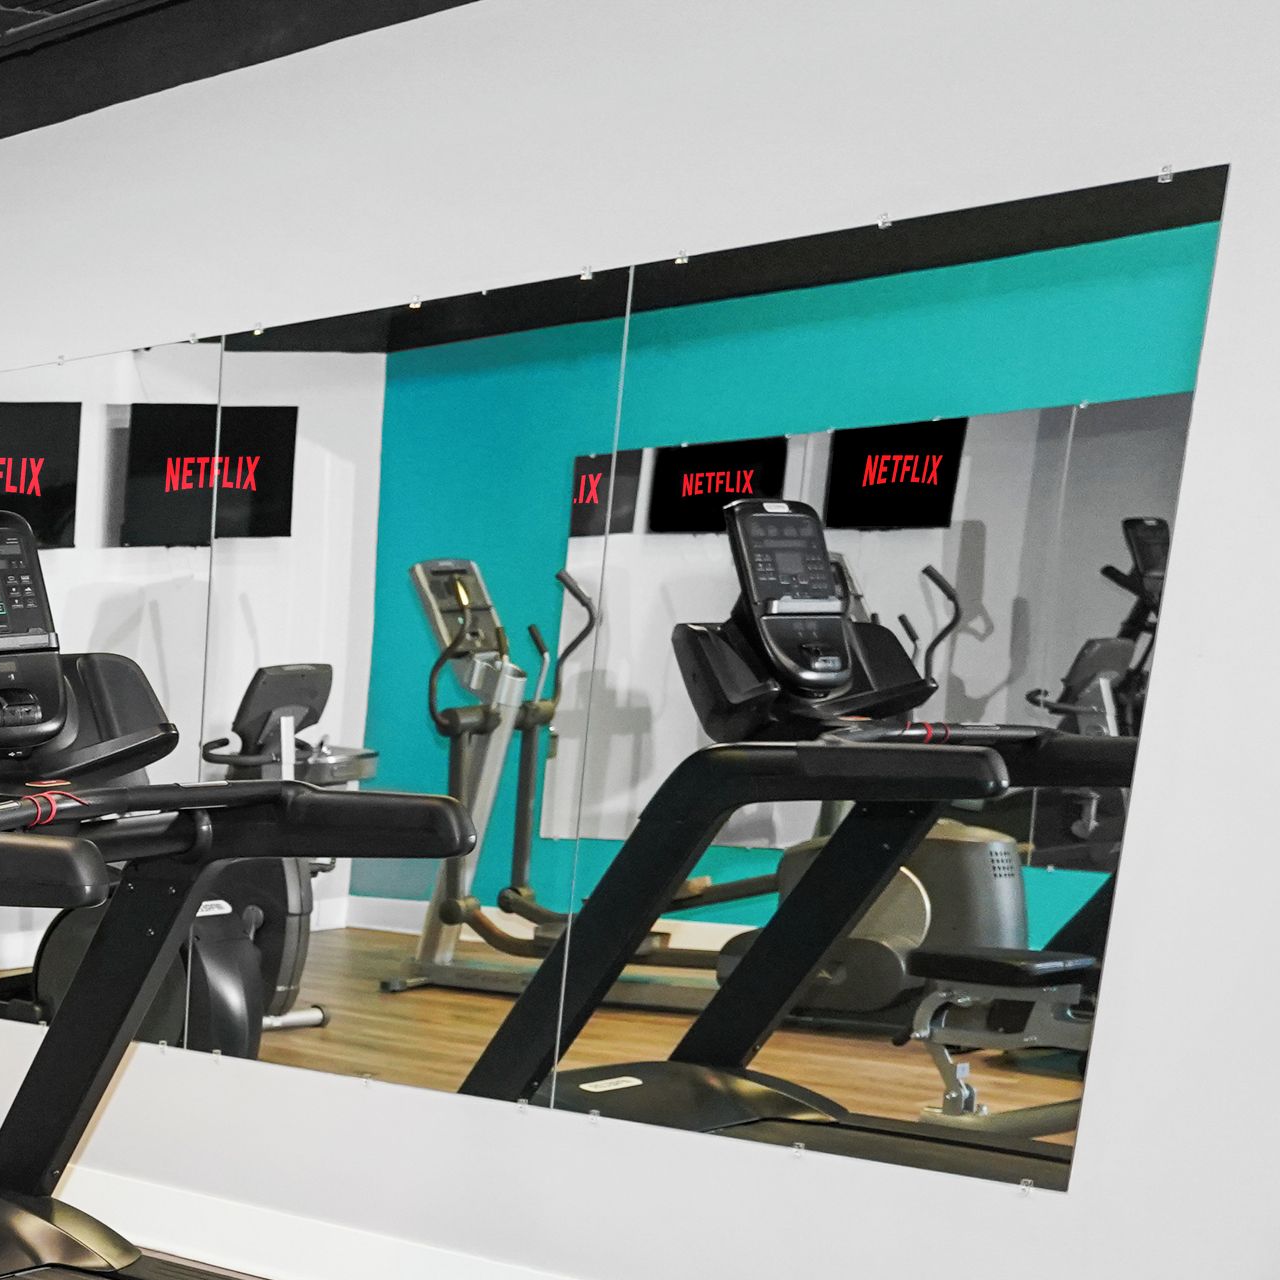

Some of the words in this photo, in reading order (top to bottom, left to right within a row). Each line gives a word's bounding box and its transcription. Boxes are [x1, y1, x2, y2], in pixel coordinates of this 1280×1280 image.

[164, 455, 261, 493] NETFLIX
[681, 469, 754, 497] NETFLIX
[861, 454, 943, 488] NETFLIX
[573, 472, 603, 505] IX
